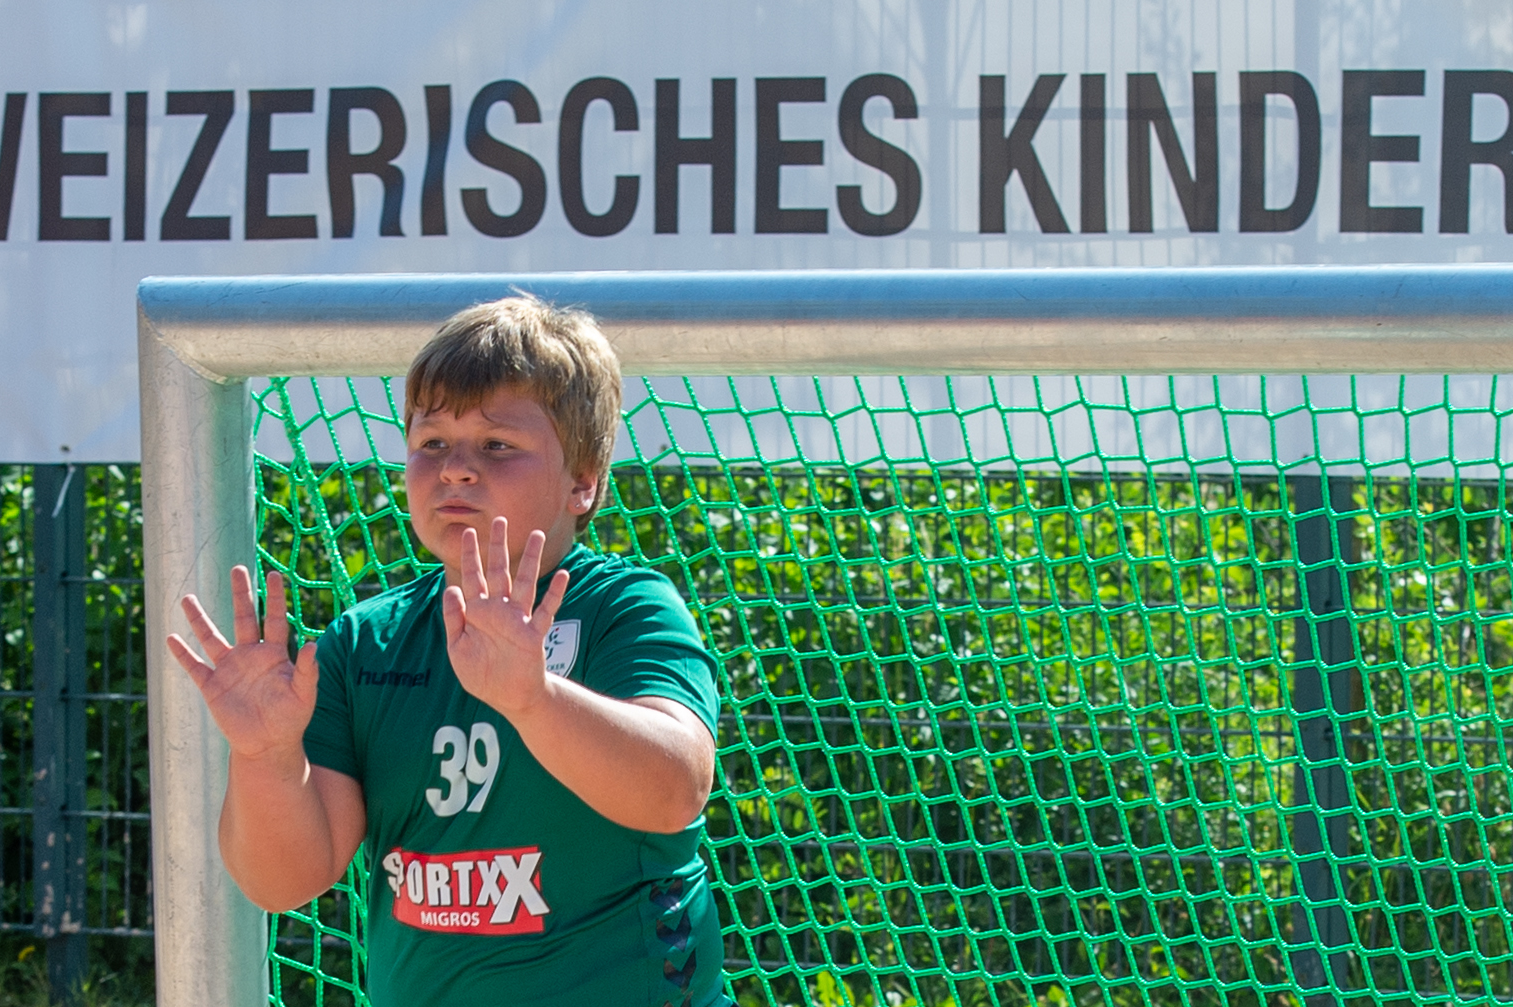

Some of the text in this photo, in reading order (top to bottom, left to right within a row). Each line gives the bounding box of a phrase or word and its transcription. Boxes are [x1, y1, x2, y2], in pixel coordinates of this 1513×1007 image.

[978, 69, 1513, 235] KINDER
[356, 666, 431, 688] hummel
[425, 722, 501, 818] 39
[420, 911, 480, 926] MIGROS
